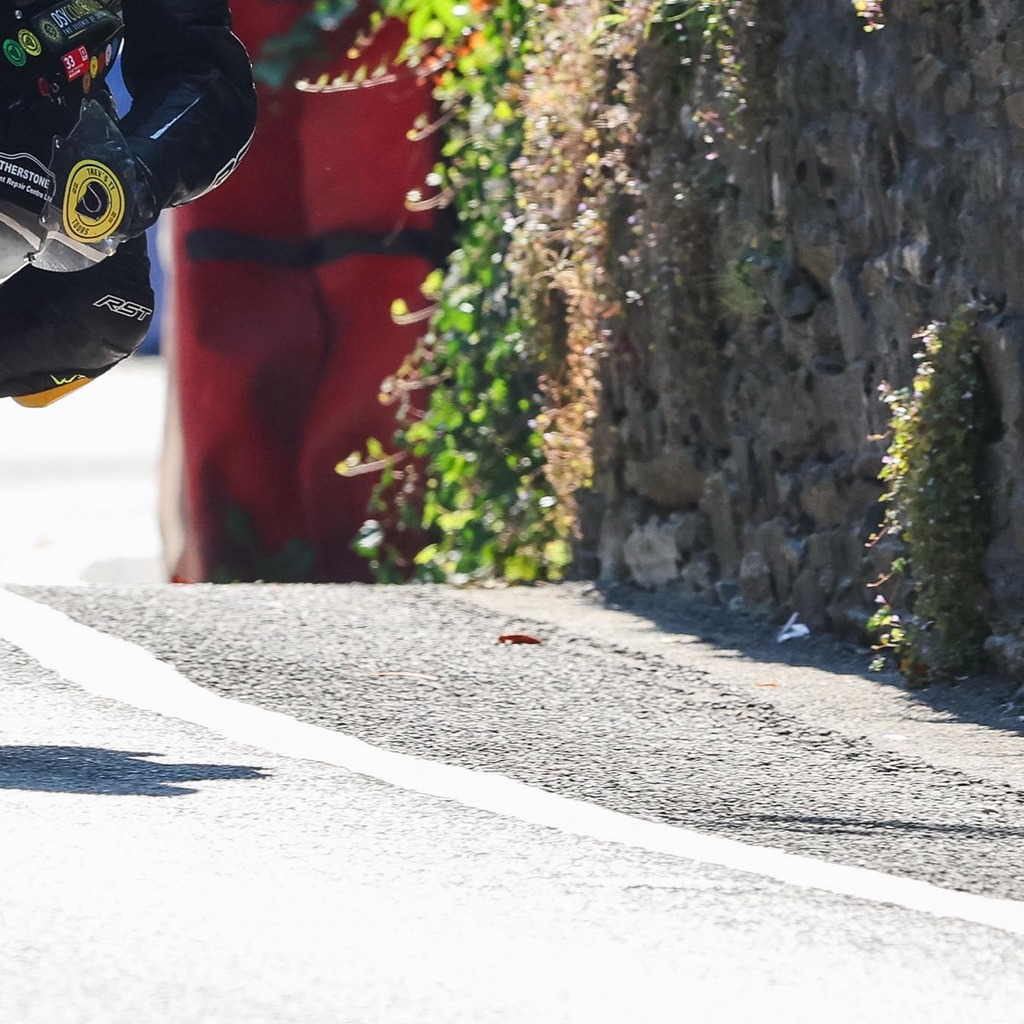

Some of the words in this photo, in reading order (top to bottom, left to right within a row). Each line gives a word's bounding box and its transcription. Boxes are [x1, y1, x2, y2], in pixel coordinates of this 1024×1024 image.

[63, 55, 76, 70] 33
[6, 177, 26, 191] Repair
[25, 184, 44, 199] Centre
[44, 191, 53, 203] Ltd
[72, 219, 90, 236] TOURS
[93, 294, 153, 322] RST
